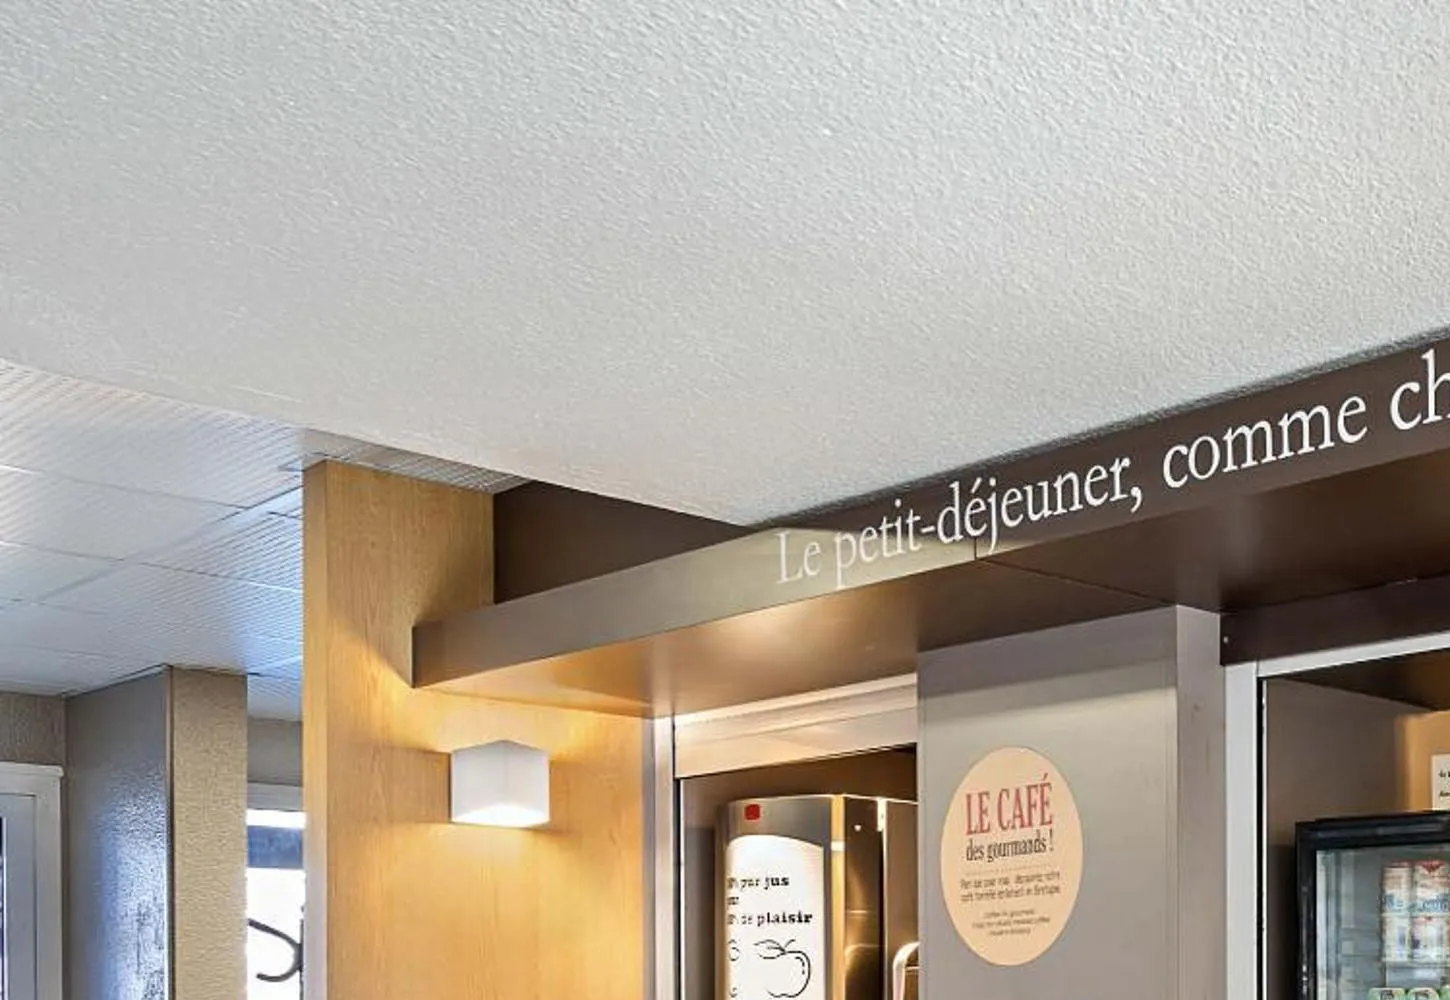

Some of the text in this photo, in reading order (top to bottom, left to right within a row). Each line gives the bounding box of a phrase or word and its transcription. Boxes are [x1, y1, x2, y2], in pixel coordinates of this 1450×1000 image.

[775, 531, 822, 585] Le
[834, 456, 1143, 589] petit-déjeuner,
[1163, 395, 1368, 489] comme
[965, 772, 1054, 836] LE CAFÉ
[966, 838, 984, 862] des
[987, 829, 1047, 863] gourmands
[763, 875, 790, 890] jus
[756, 910, 813, 928] plaisir
